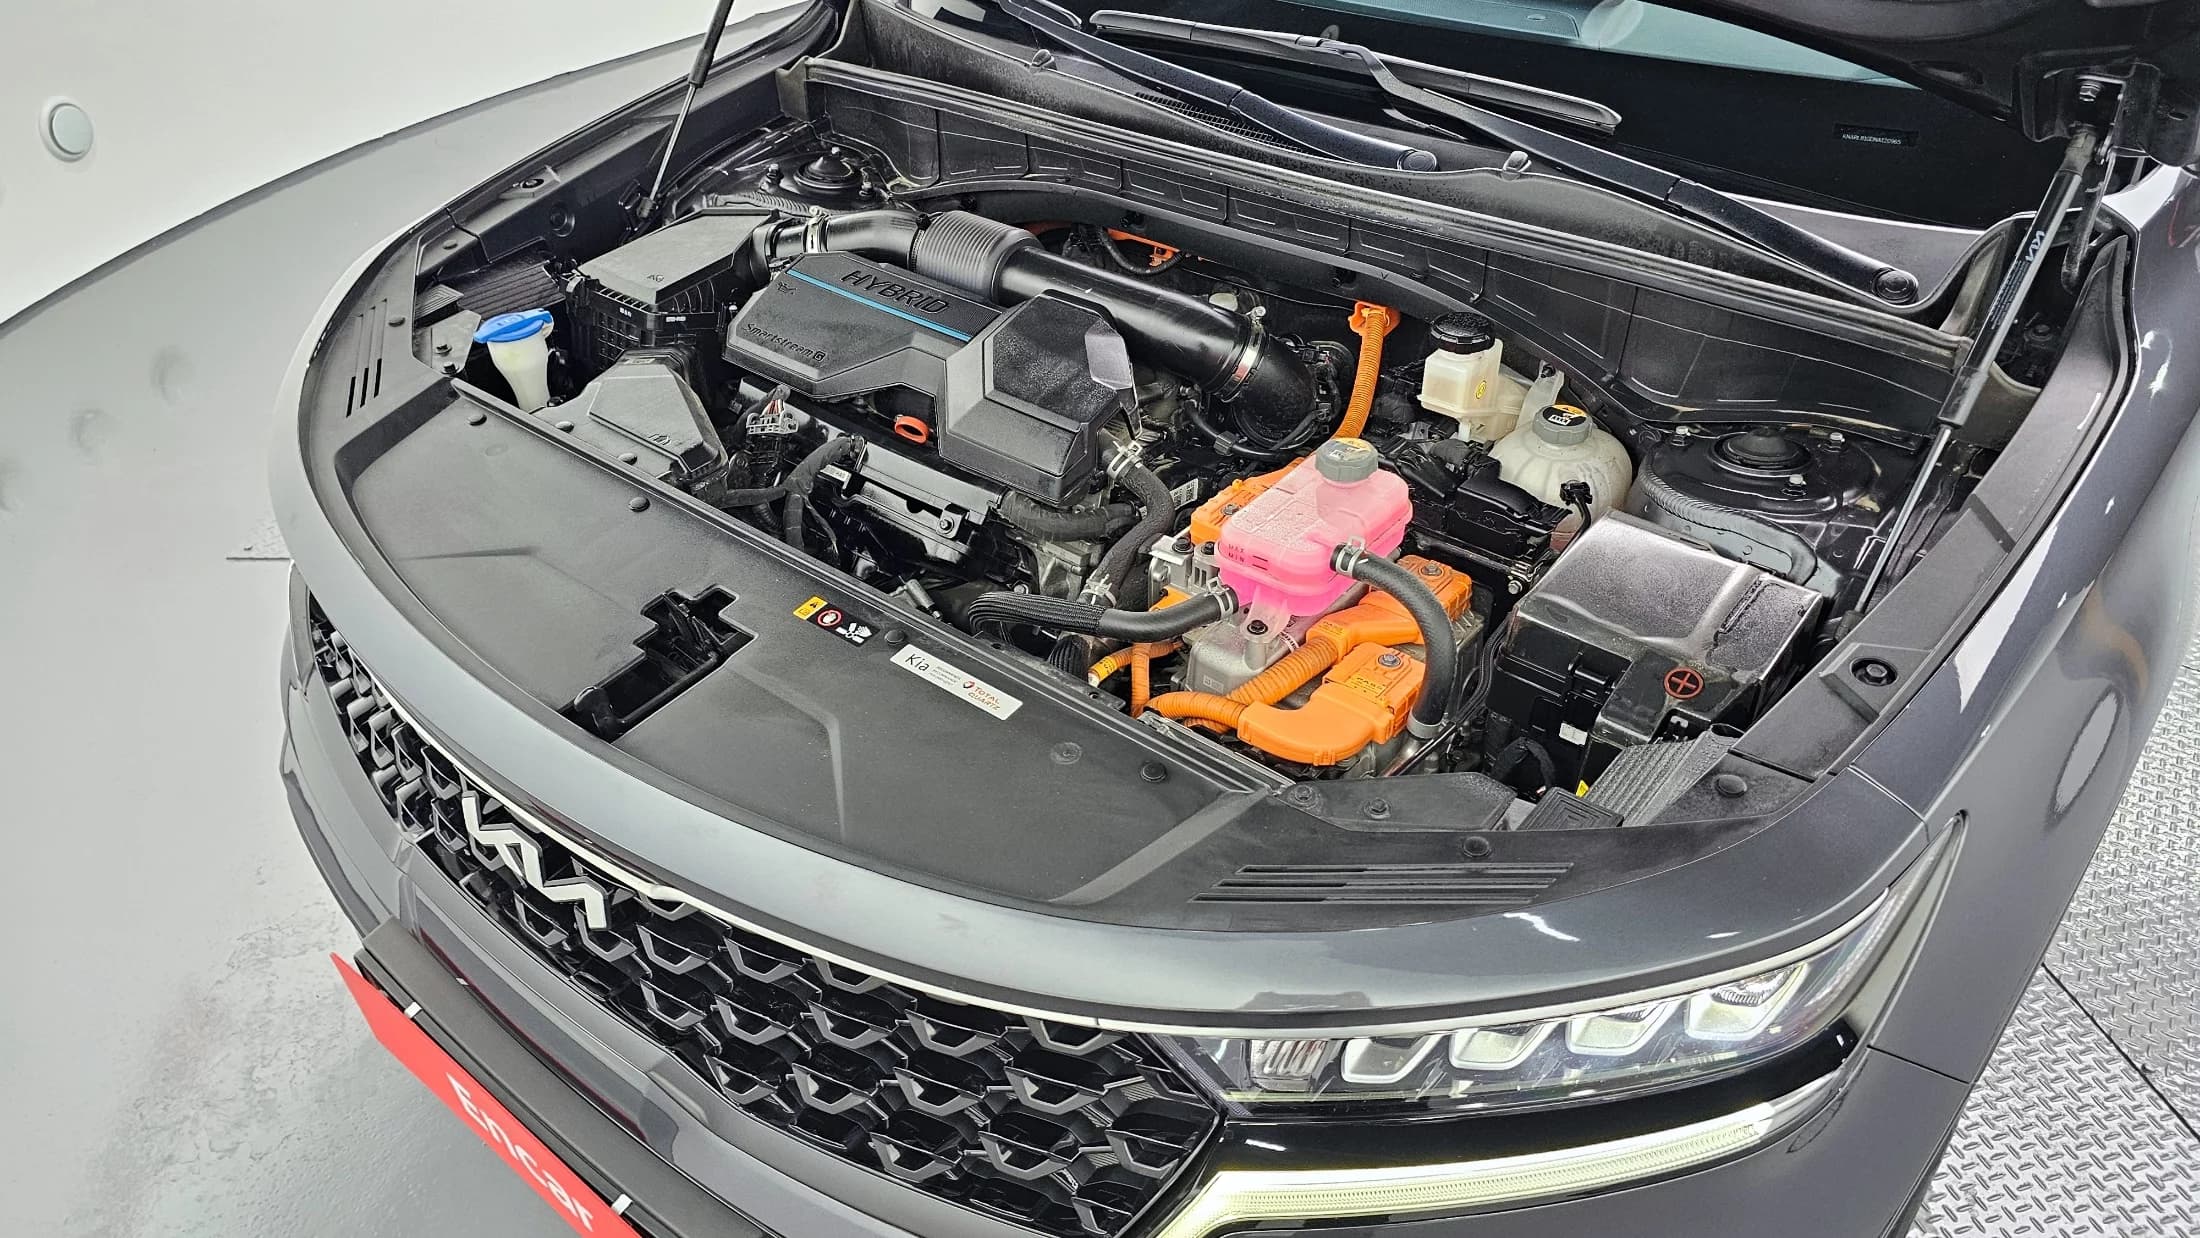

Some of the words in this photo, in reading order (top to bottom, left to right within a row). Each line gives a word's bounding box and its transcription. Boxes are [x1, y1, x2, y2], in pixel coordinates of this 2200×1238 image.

[840, 270, 949, 314] HYBRID
[745, 323, 813, 357] Smartstream
[1228, 552, 1244, 562] MIN
[905, 653, 930, 671] Kia
[968, 692, 1001, 711] QUARTZ
[974, 687, 1001, 705] TOTAL
[446, 1071, 594, 1233] Encar
